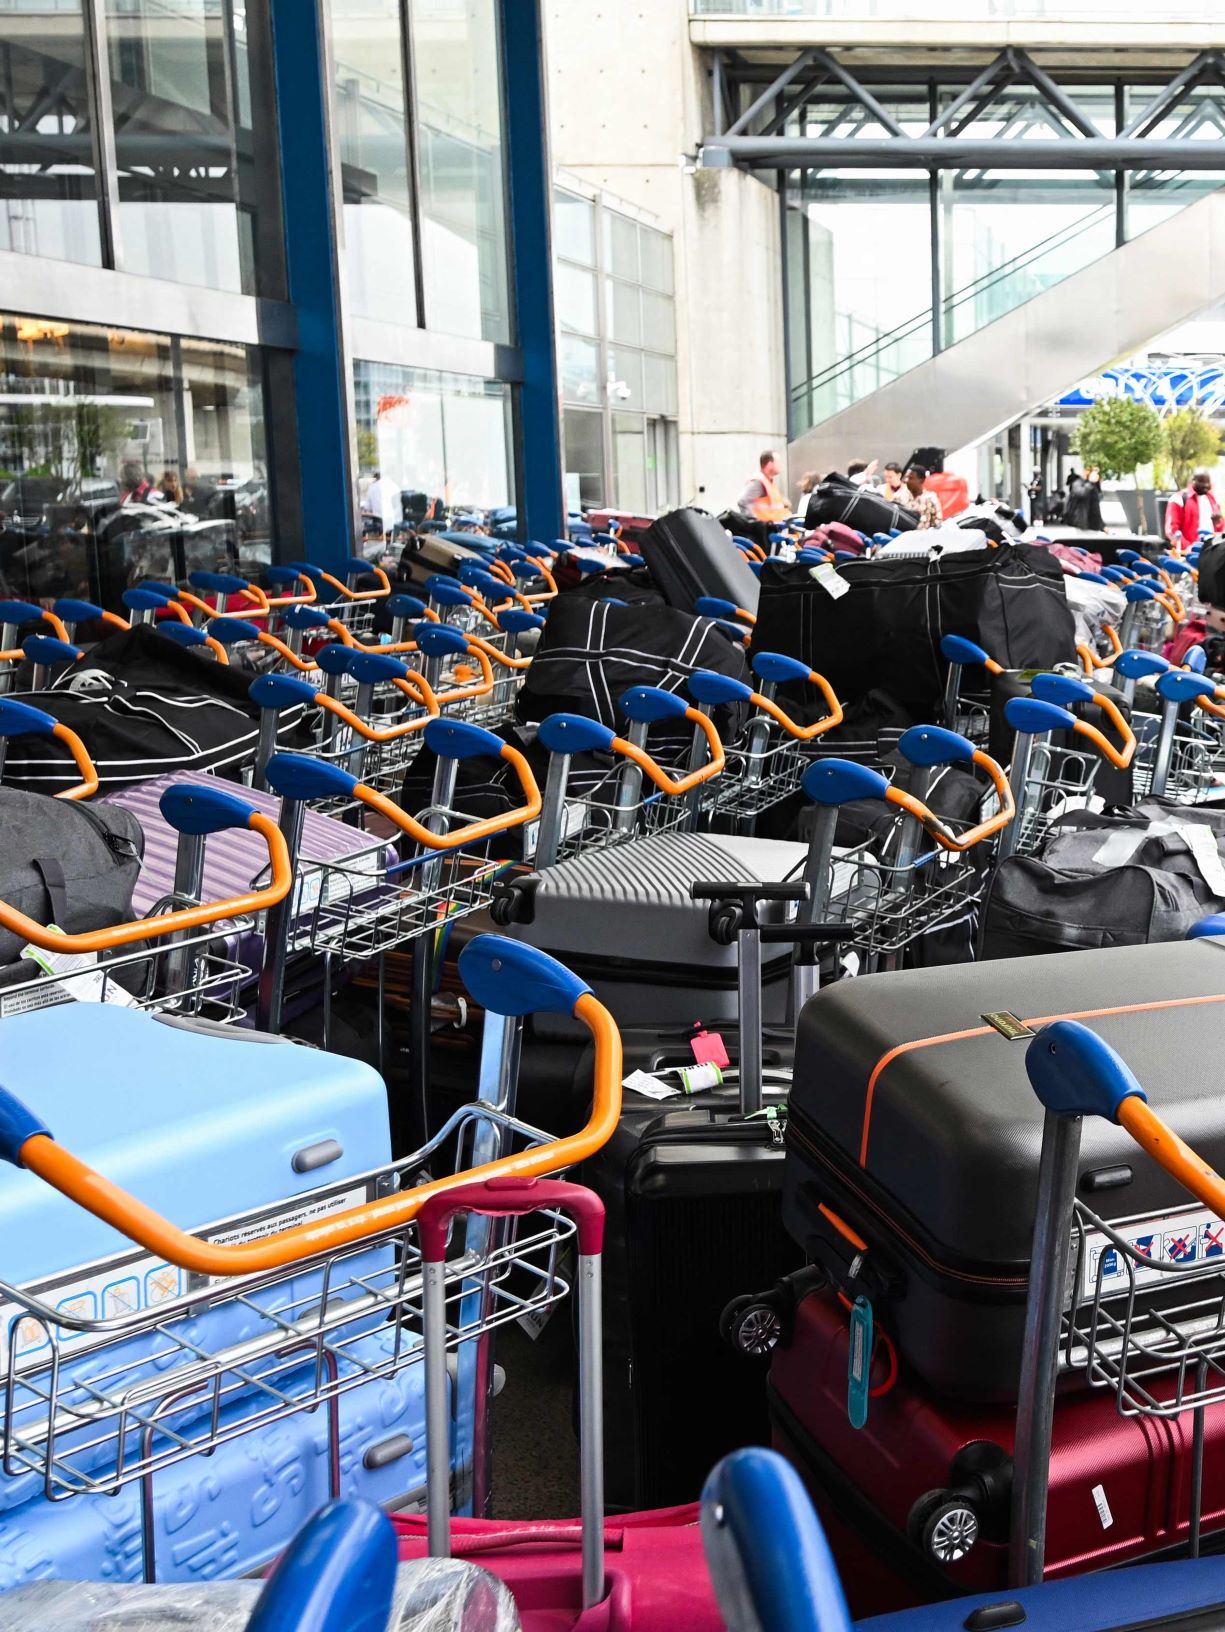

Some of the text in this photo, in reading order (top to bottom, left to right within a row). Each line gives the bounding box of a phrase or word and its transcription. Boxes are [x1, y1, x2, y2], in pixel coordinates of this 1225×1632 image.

[267, 1221, 277, 1229] aux
[317, 1205, 327, 1214] pas
[327, 1198, 347, 1208] utiliser
